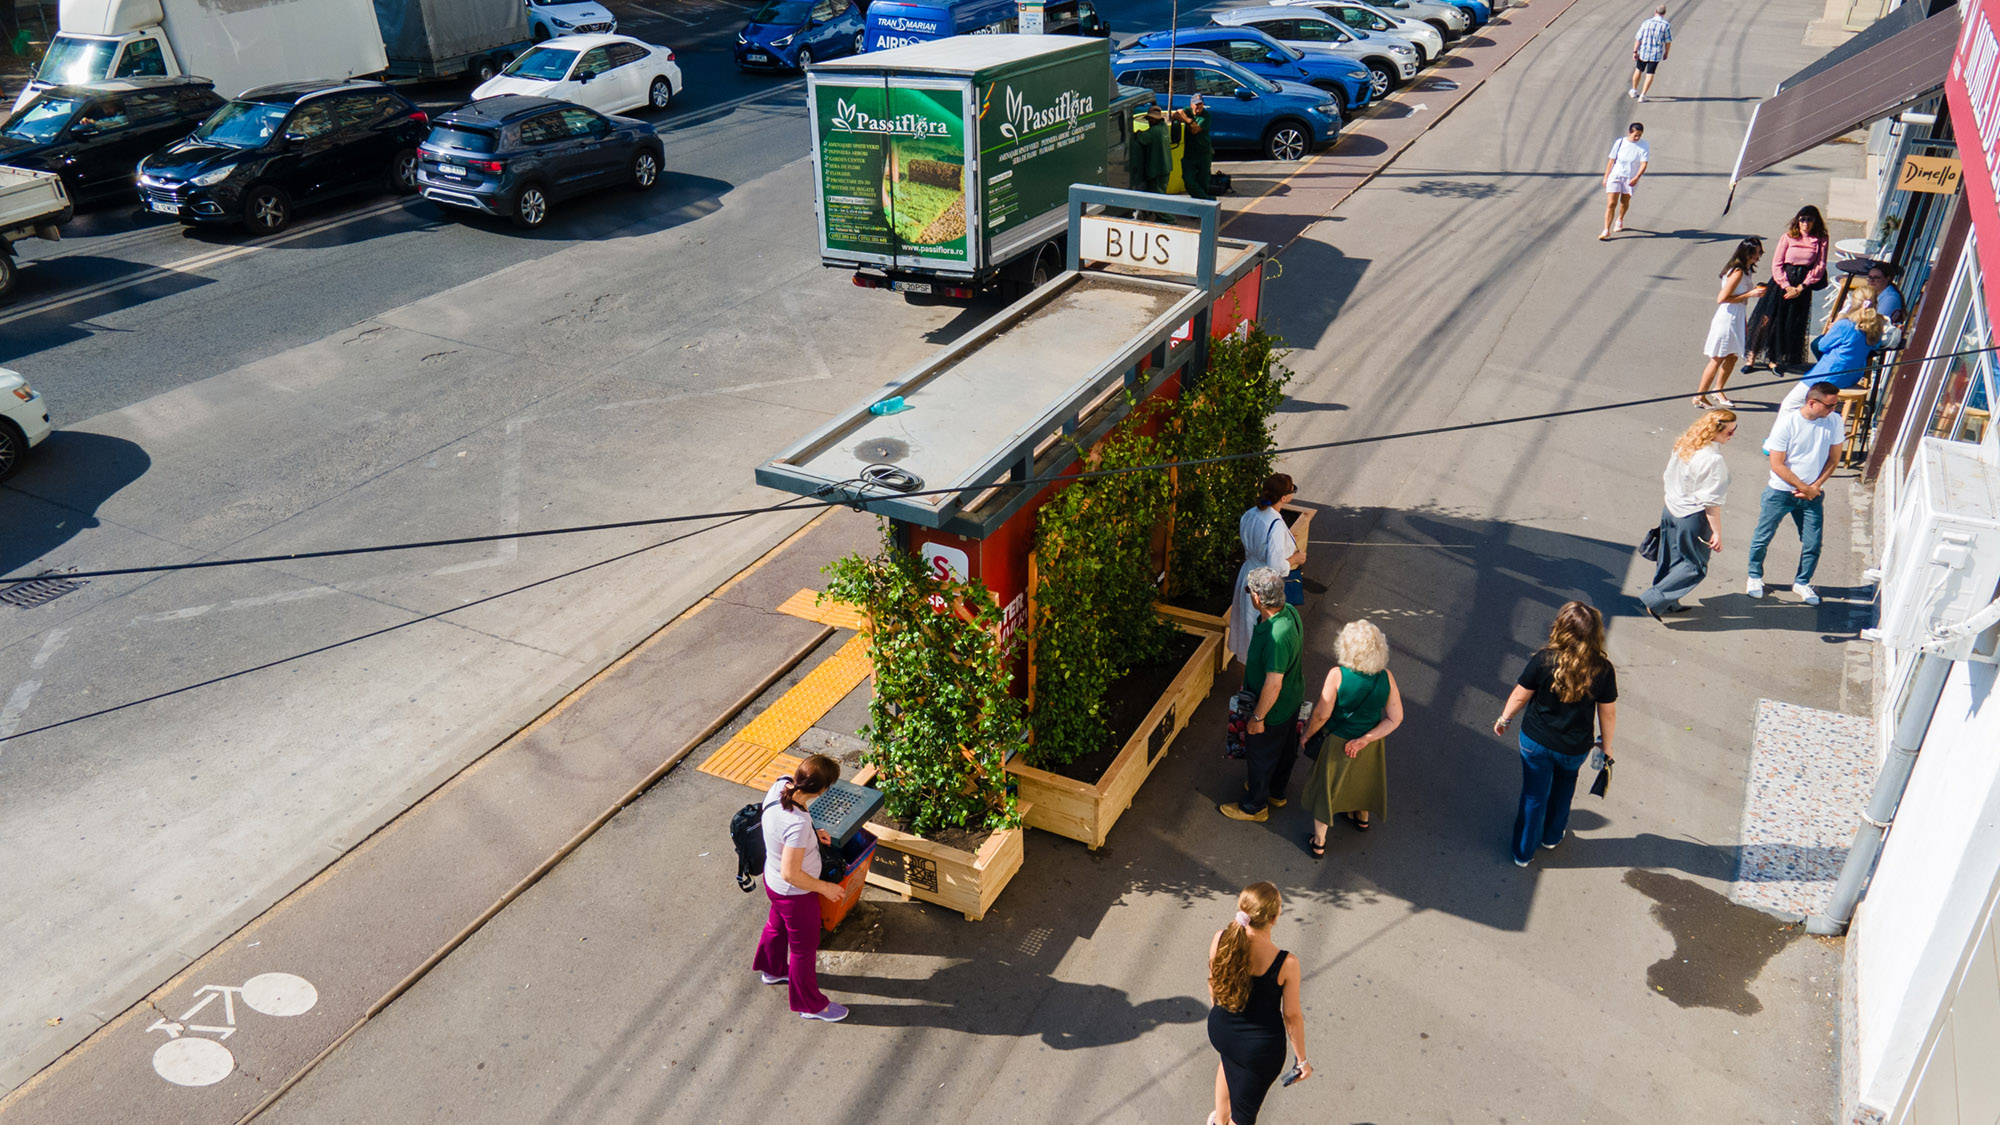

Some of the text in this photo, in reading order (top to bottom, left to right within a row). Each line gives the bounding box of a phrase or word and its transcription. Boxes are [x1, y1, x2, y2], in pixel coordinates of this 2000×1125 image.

[878, 17, 937, 31] TRANSMARIAN
[856, 112, 948, 137] Passiflora
[1022, 90, 1094, 134] Passiflora
[901, 243, 964, 256] www.passiflora.ro
[1106, 227, 1170, 265] BUS
